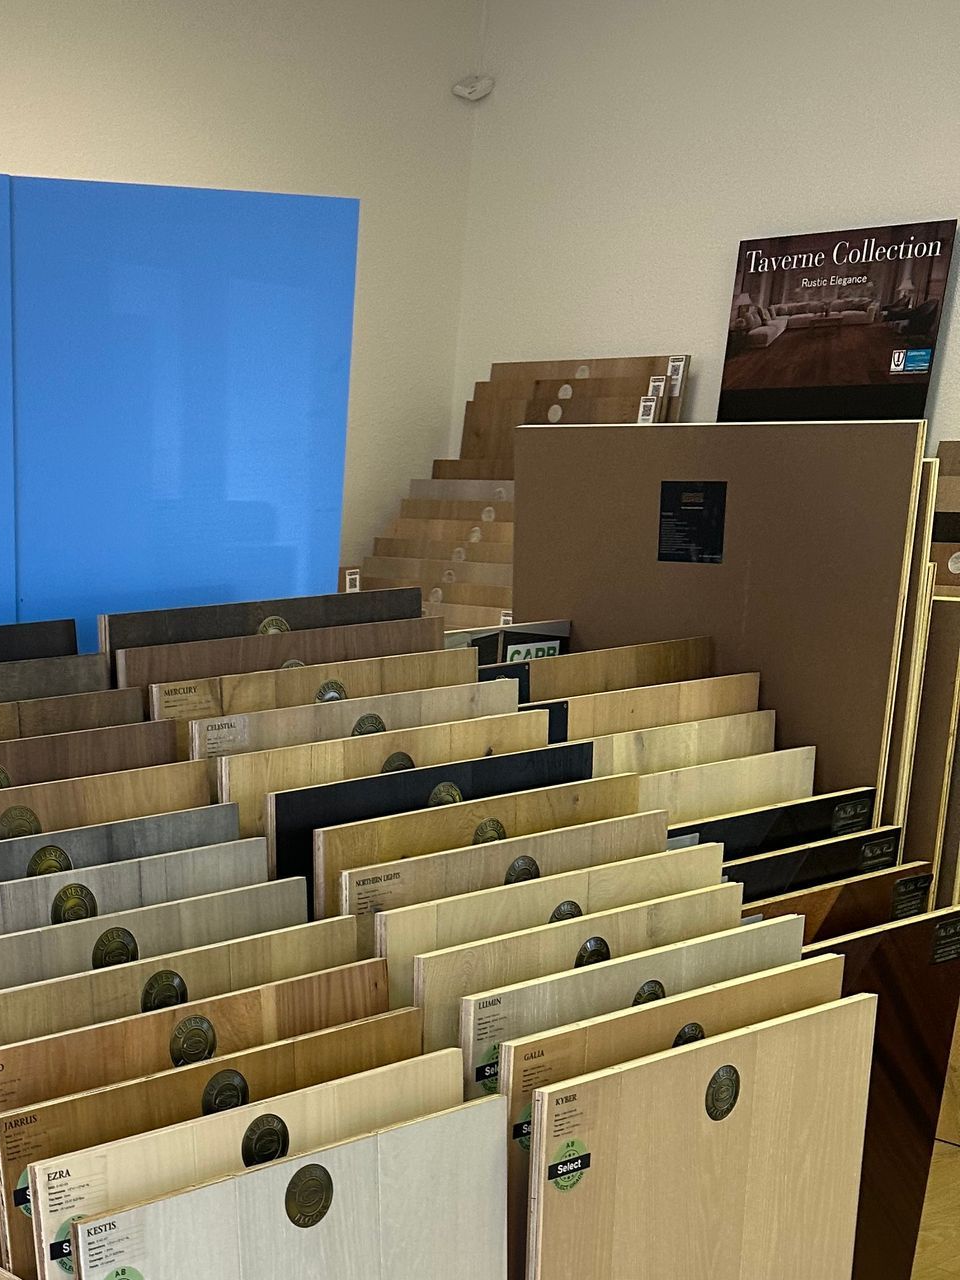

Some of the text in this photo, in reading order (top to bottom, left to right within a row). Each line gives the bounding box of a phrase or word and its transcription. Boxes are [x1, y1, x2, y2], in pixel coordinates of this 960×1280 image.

[746, 236, 942, 273] Taverne Collection
[801, 275, 868, 288] Rustic Elegance
[163, 685, 198, 697] MERCURY
[355, 872, 401, 887] NORTHERN LIGHTS
[3, 1114, 38, 1133] JARRUS
[557, 1159, 582, 1174] Select
[47, 1168, 71, 1182] EZRA
[86, 1220, 117, 1238] KESTIS
[114, 1268, 127, 1278] AB
